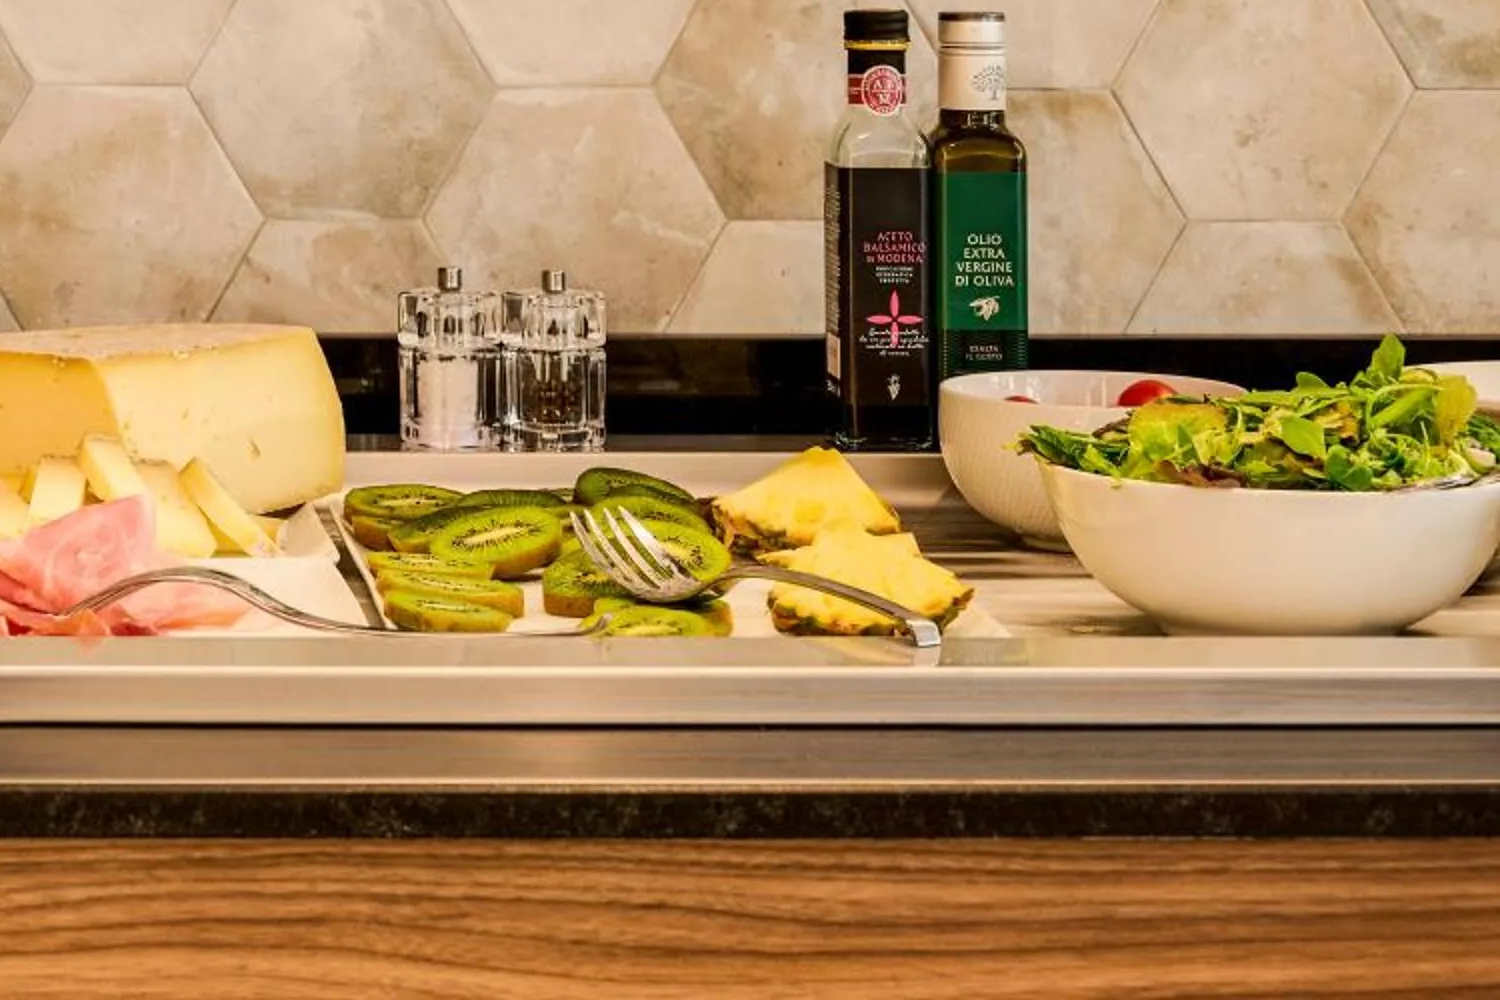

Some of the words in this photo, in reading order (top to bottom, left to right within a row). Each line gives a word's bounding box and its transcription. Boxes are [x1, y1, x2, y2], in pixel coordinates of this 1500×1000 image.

[877, 231, 913, 241] ACETO
[966, 233, 1003, 246] OLIO
[863, 241, 927, 253] BALSAMICO
[877, 253, 924, 264] MODENA
[963, 247, 1006, 260] EXTRA
[955, 261, 1013, 273] VERGINE
[955, 275, 970, 287] DI
[973, 274, 1015, 287] OLIVA
